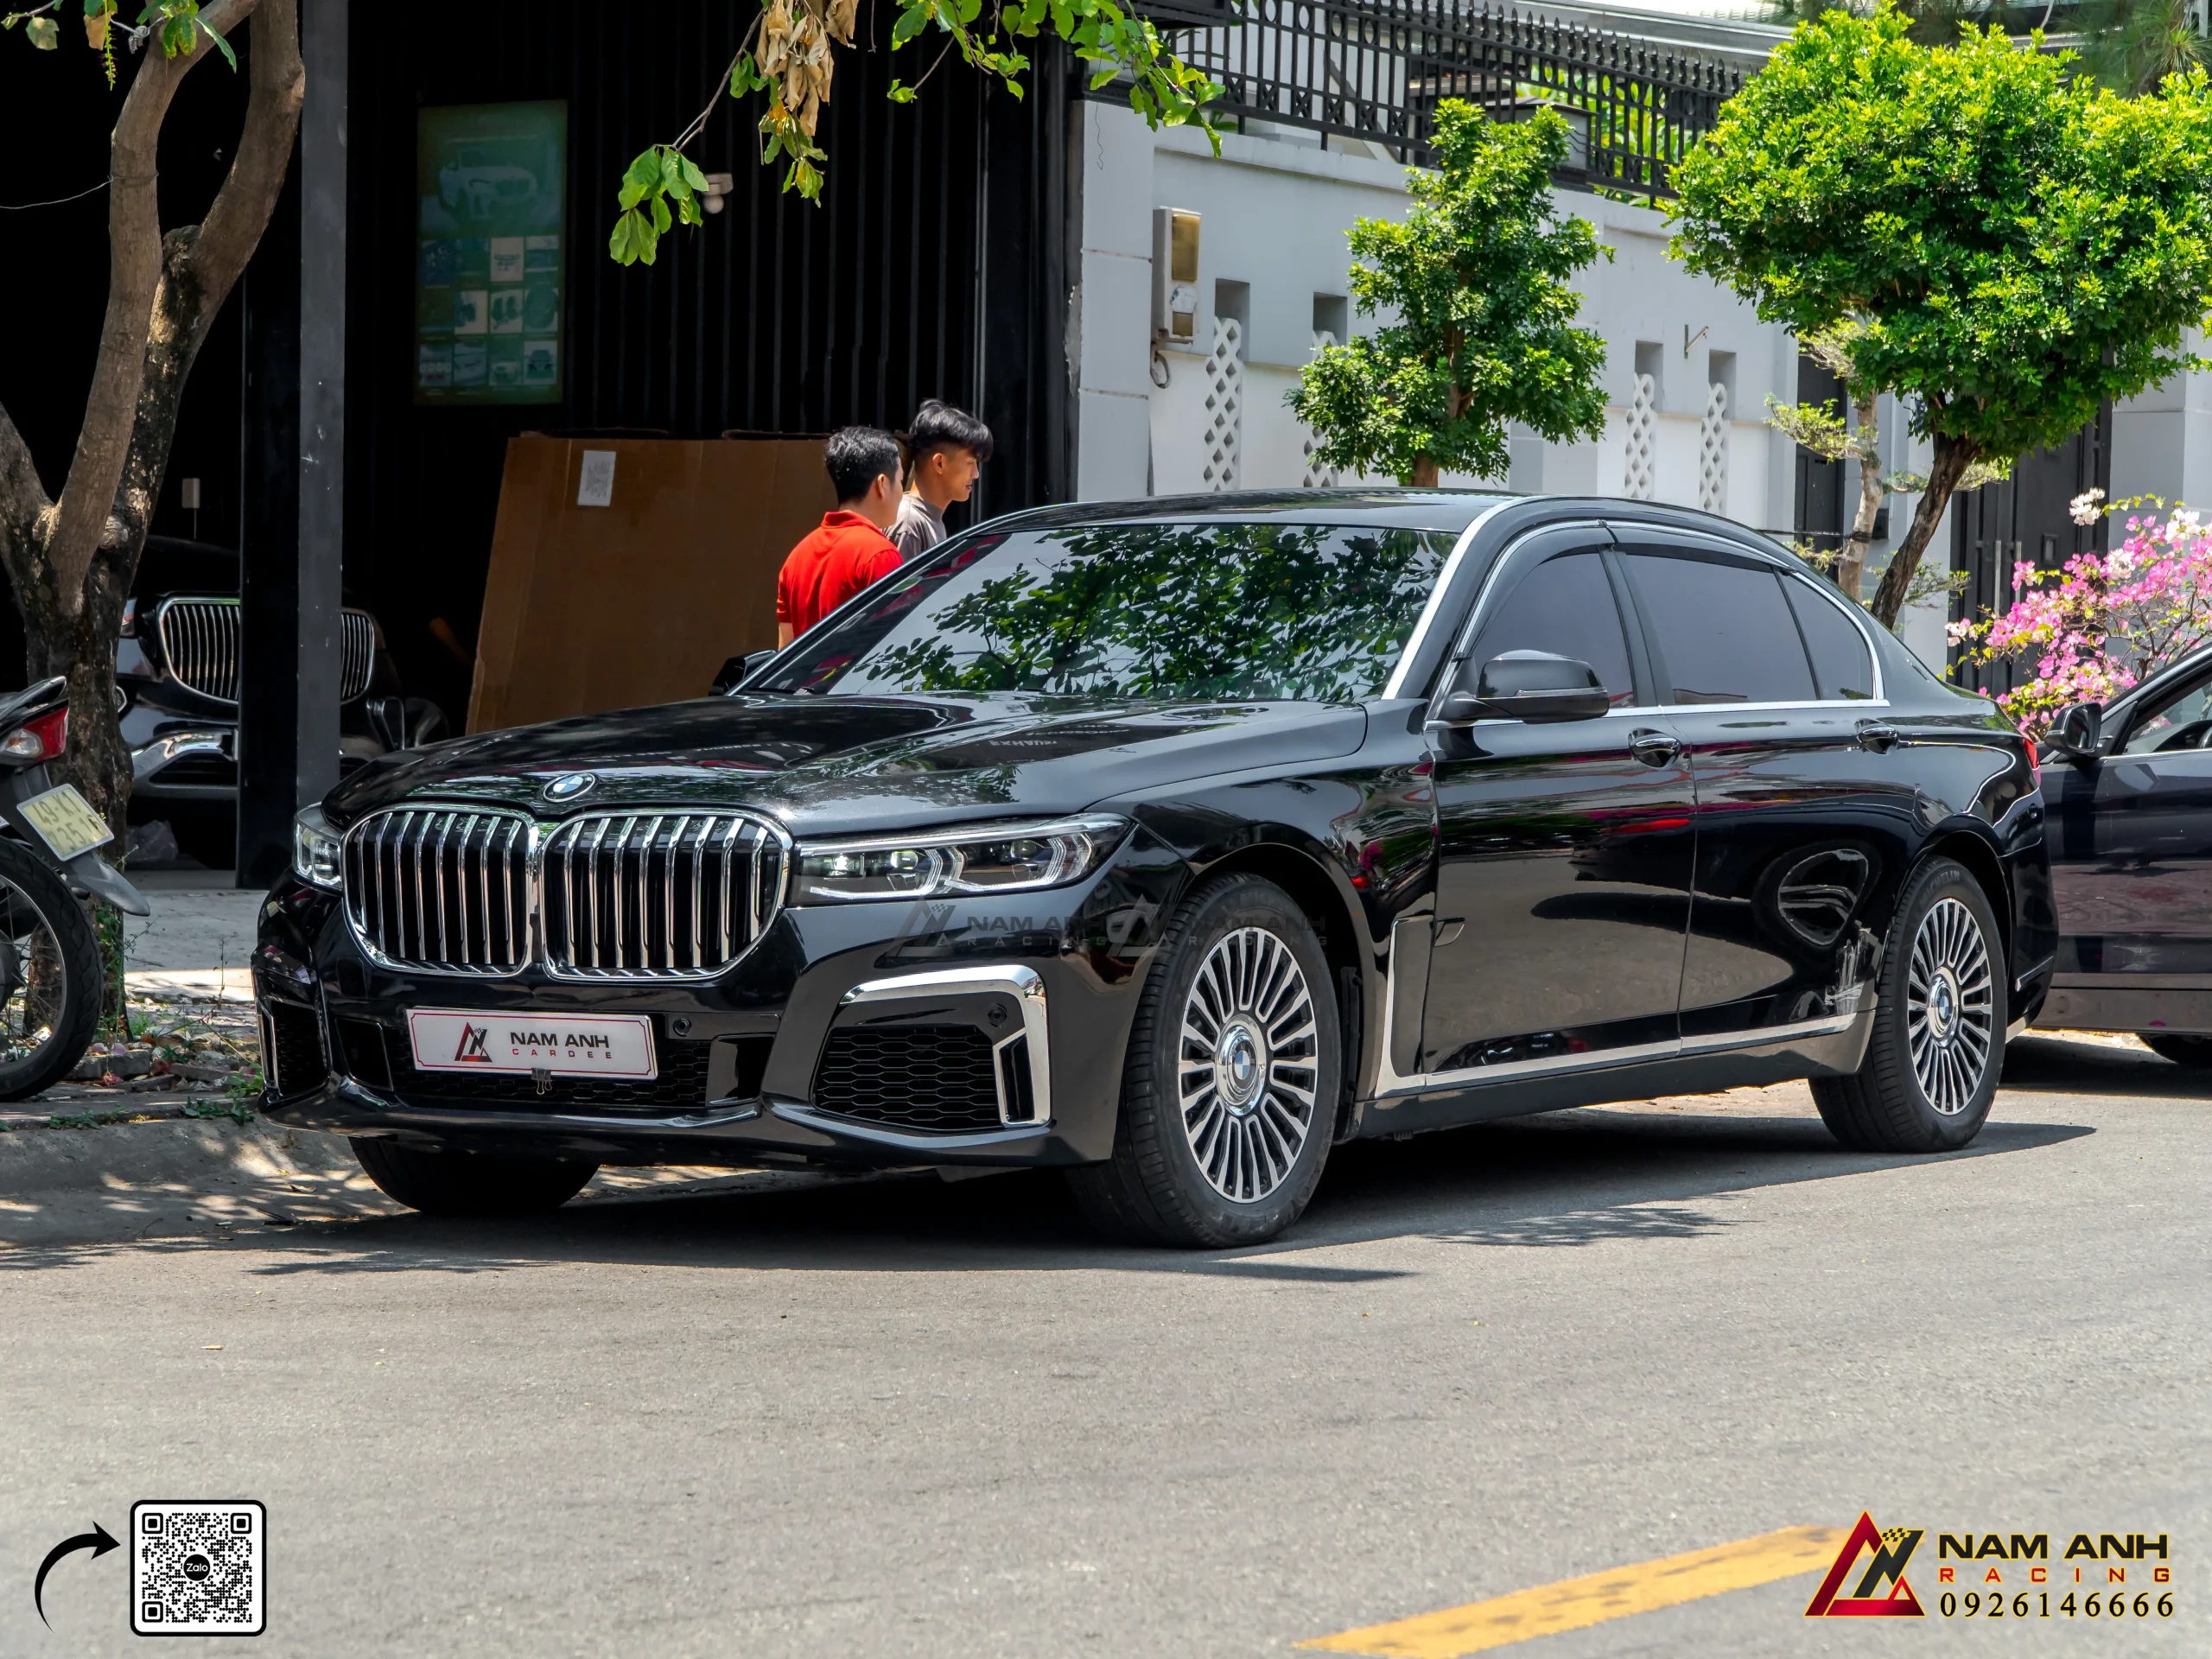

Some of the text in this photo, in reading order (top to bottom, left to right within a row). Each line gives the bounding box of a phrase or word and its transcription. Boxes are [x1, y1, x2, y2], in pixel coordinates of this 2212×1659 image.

[510, 1032, 609, 1048] NAM ANH
[512, 1048, 612, 1058] CARDEE
